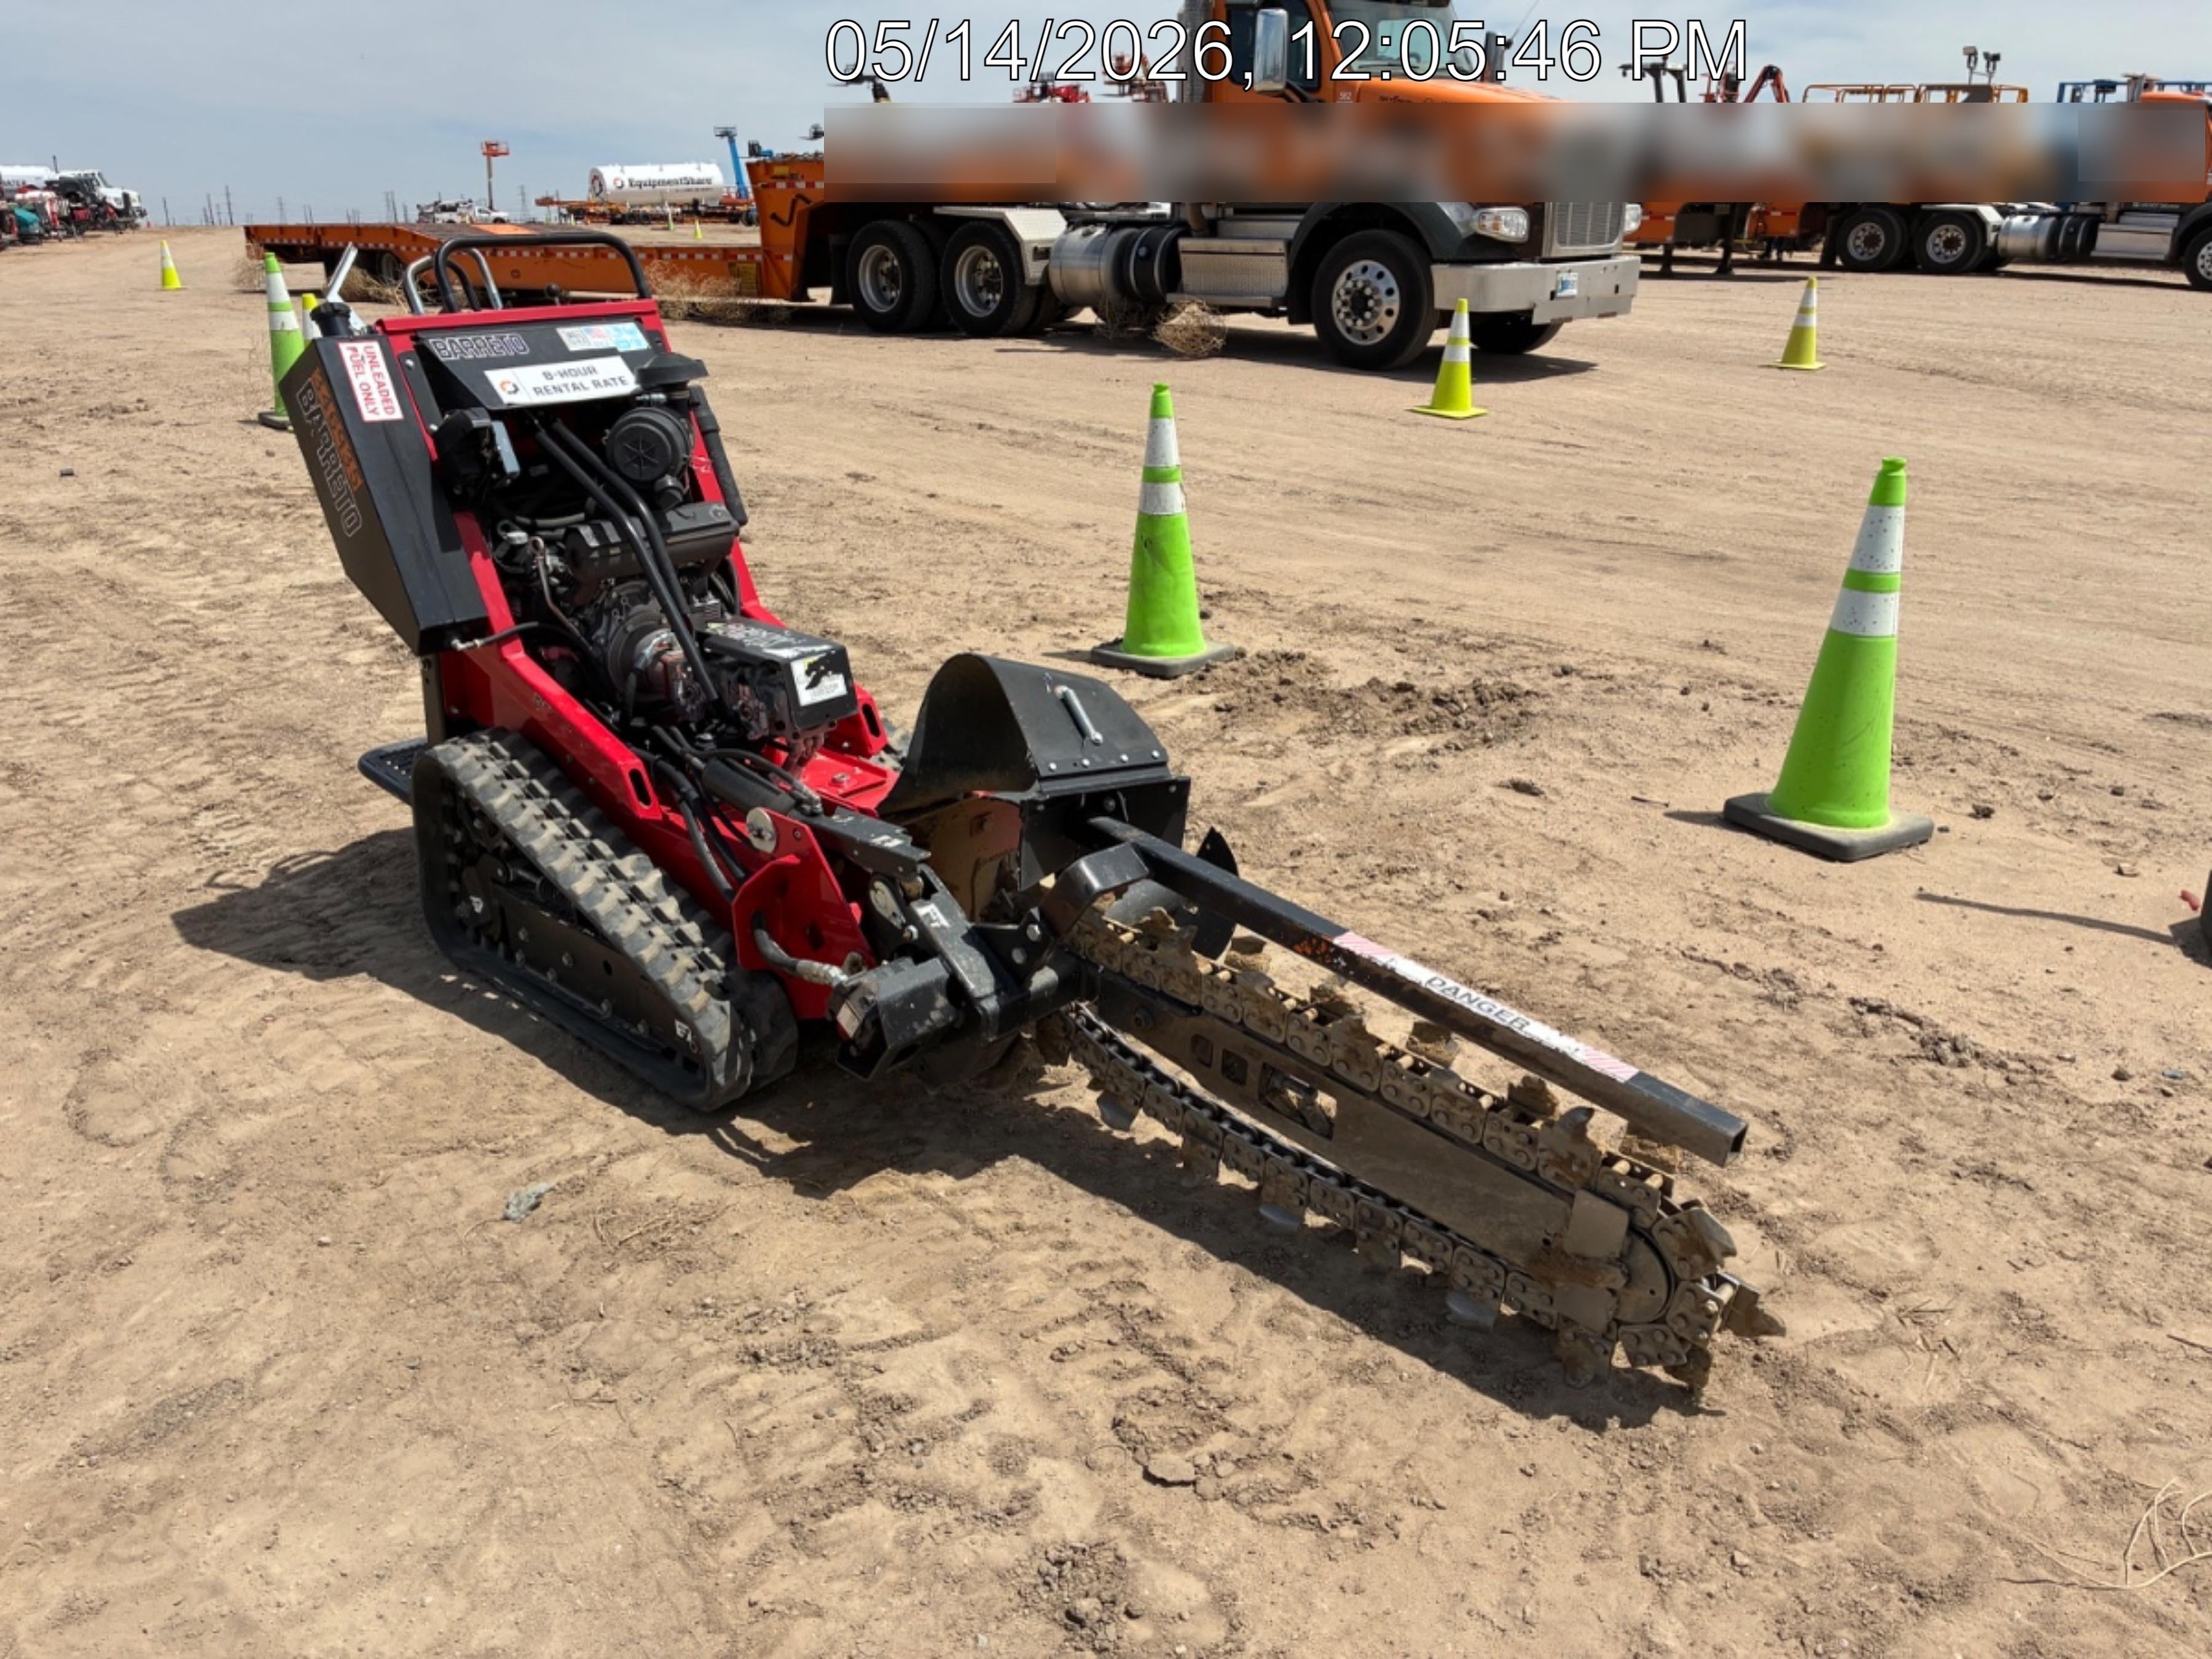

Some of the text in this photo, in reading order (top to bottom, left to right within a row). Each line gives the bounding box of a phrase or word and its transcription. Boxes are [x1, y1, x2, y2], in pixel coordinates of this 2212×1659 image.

[628, 176, 713, 189] EquipmentShare
[429, 333, 530, 360] BARRETO
[346, 346, 380, 417] FUEL ONLY
[363, 345, 396, 415] UNLEADED
[532, 375, 630, 397] RENTAL RATE
[542, 366, 598, 381] 8-HOUR
[296, 378, 363, 537] BARRETO
[1424, 975, 1535, 1032] DANGER
